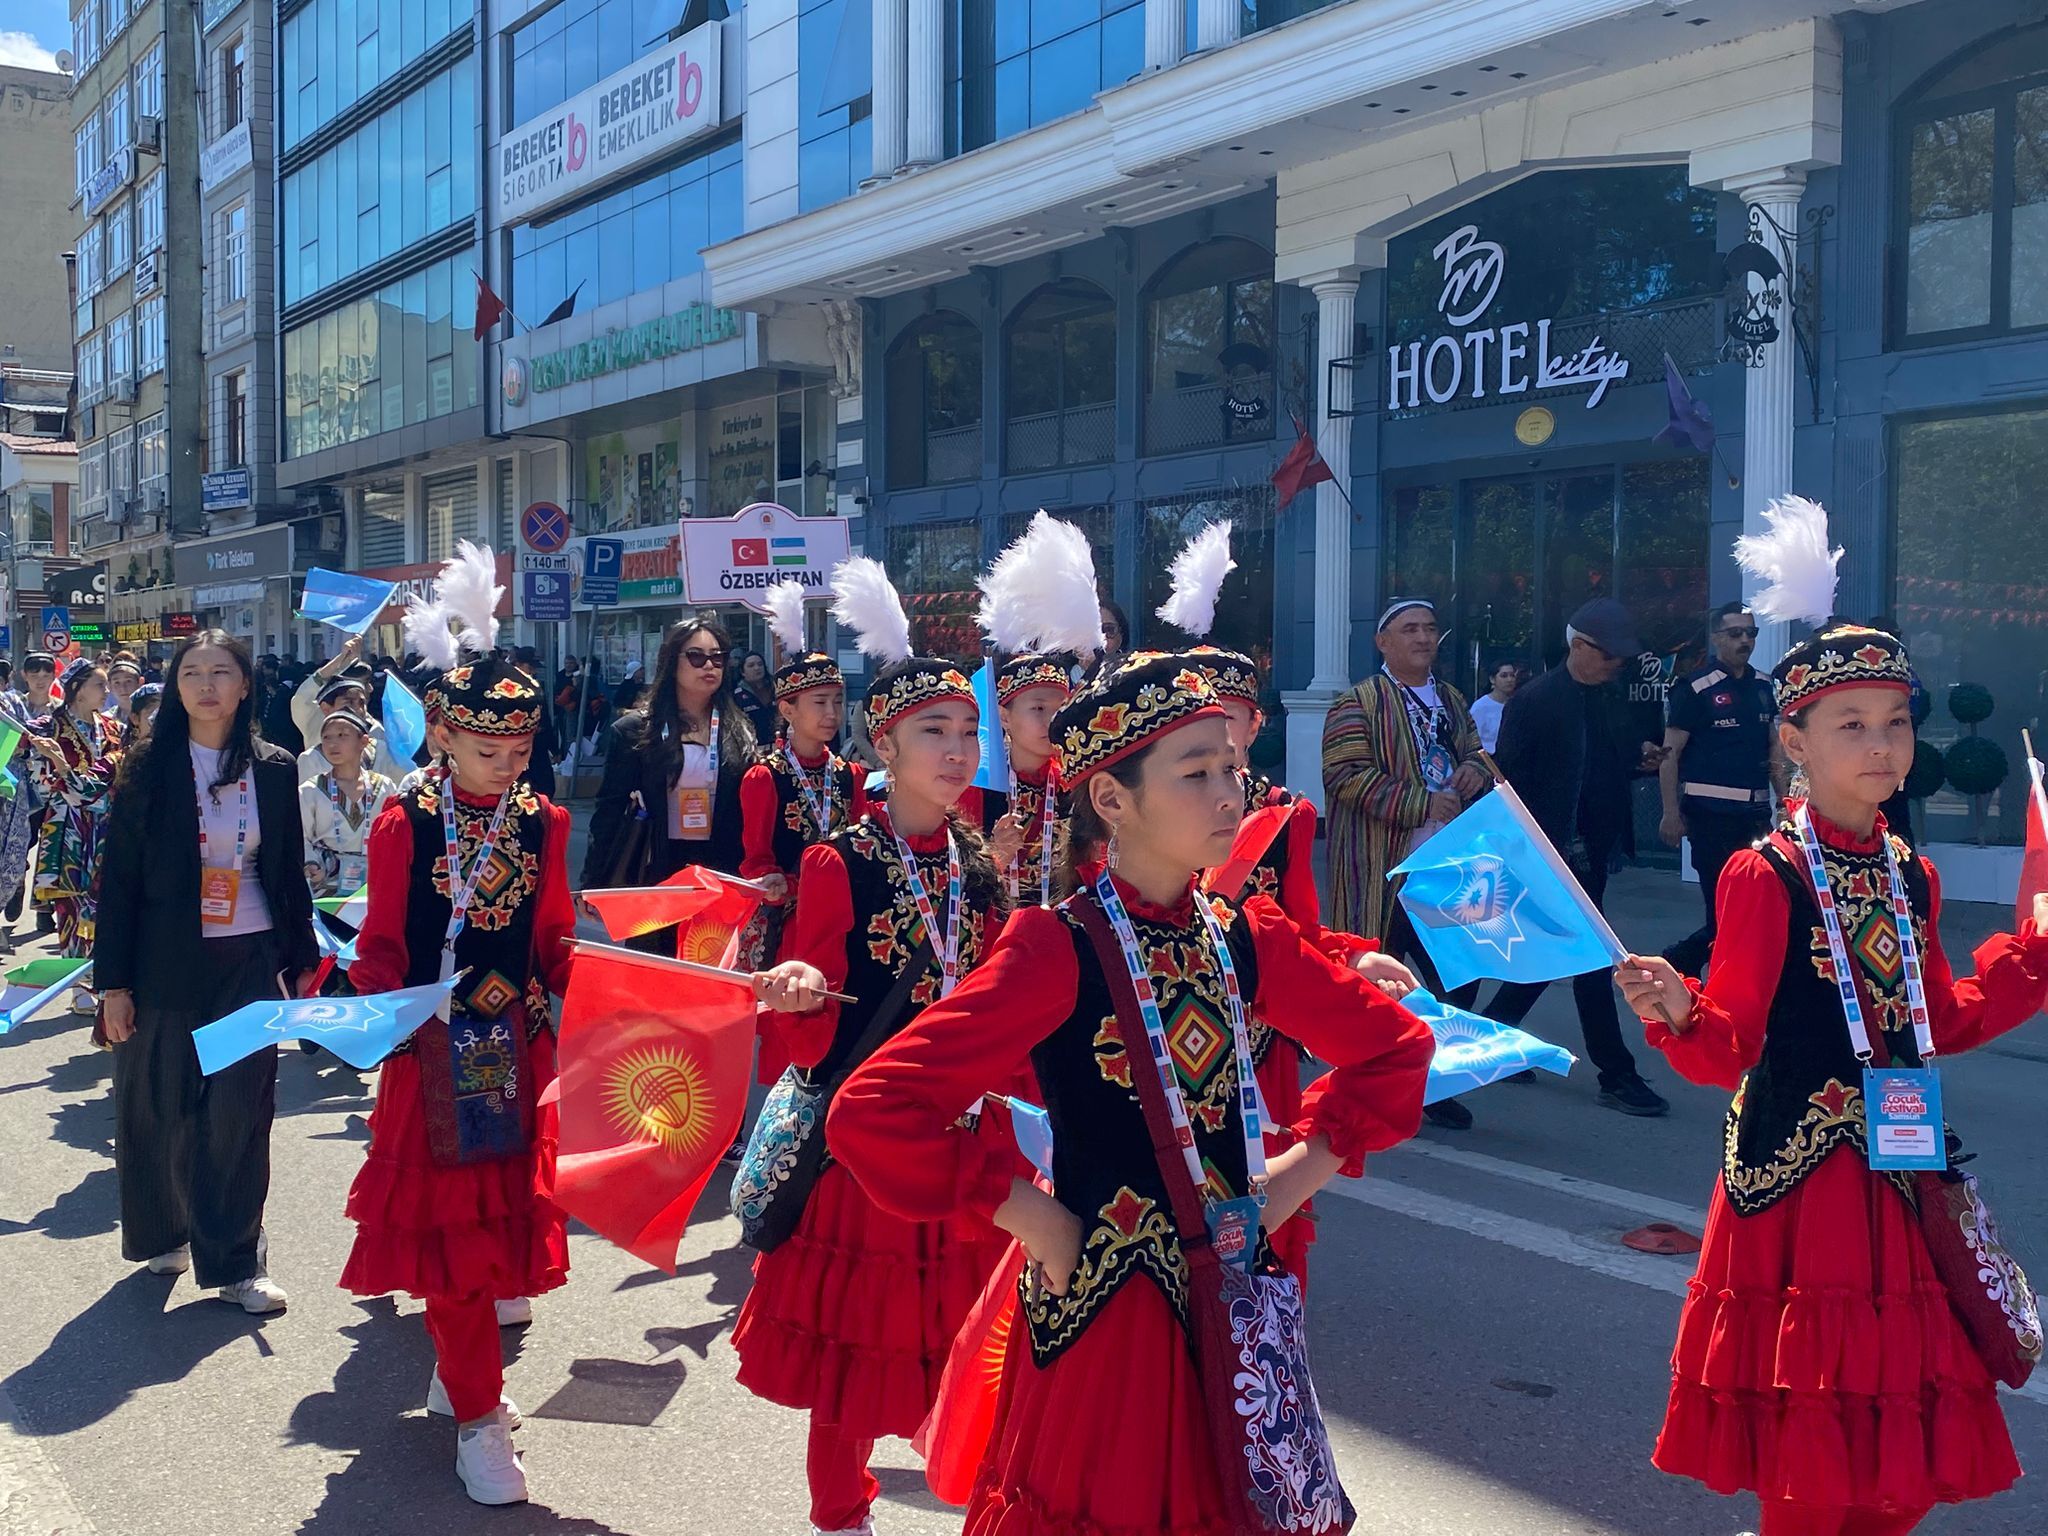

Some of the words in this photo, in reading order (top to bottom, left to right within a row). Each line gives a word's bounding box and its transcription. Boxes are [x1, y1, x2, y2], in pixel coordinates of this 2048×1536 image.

[599, 57, 676, 128] BEREKET
[503, 118, 566, 178] BEREKET
[1737, 315, 1770, 335] HOTEL
[1388, 318, 1552, 410] HOTEL
[1228, 398, 1260, 413] HOTEL
[228, 549, 255, 569] Telekom
[534, 556, 552, 569] 140
[554, 557, 567, 569] mt
[594, 544, 615, 574] P
[650, 580, 676, 595] market
[719, 568, 823, 590] ÖZBEKİSTAN
[70, 589, 105, 605] Res
[1628, 683, 1670, 702] HOTE
